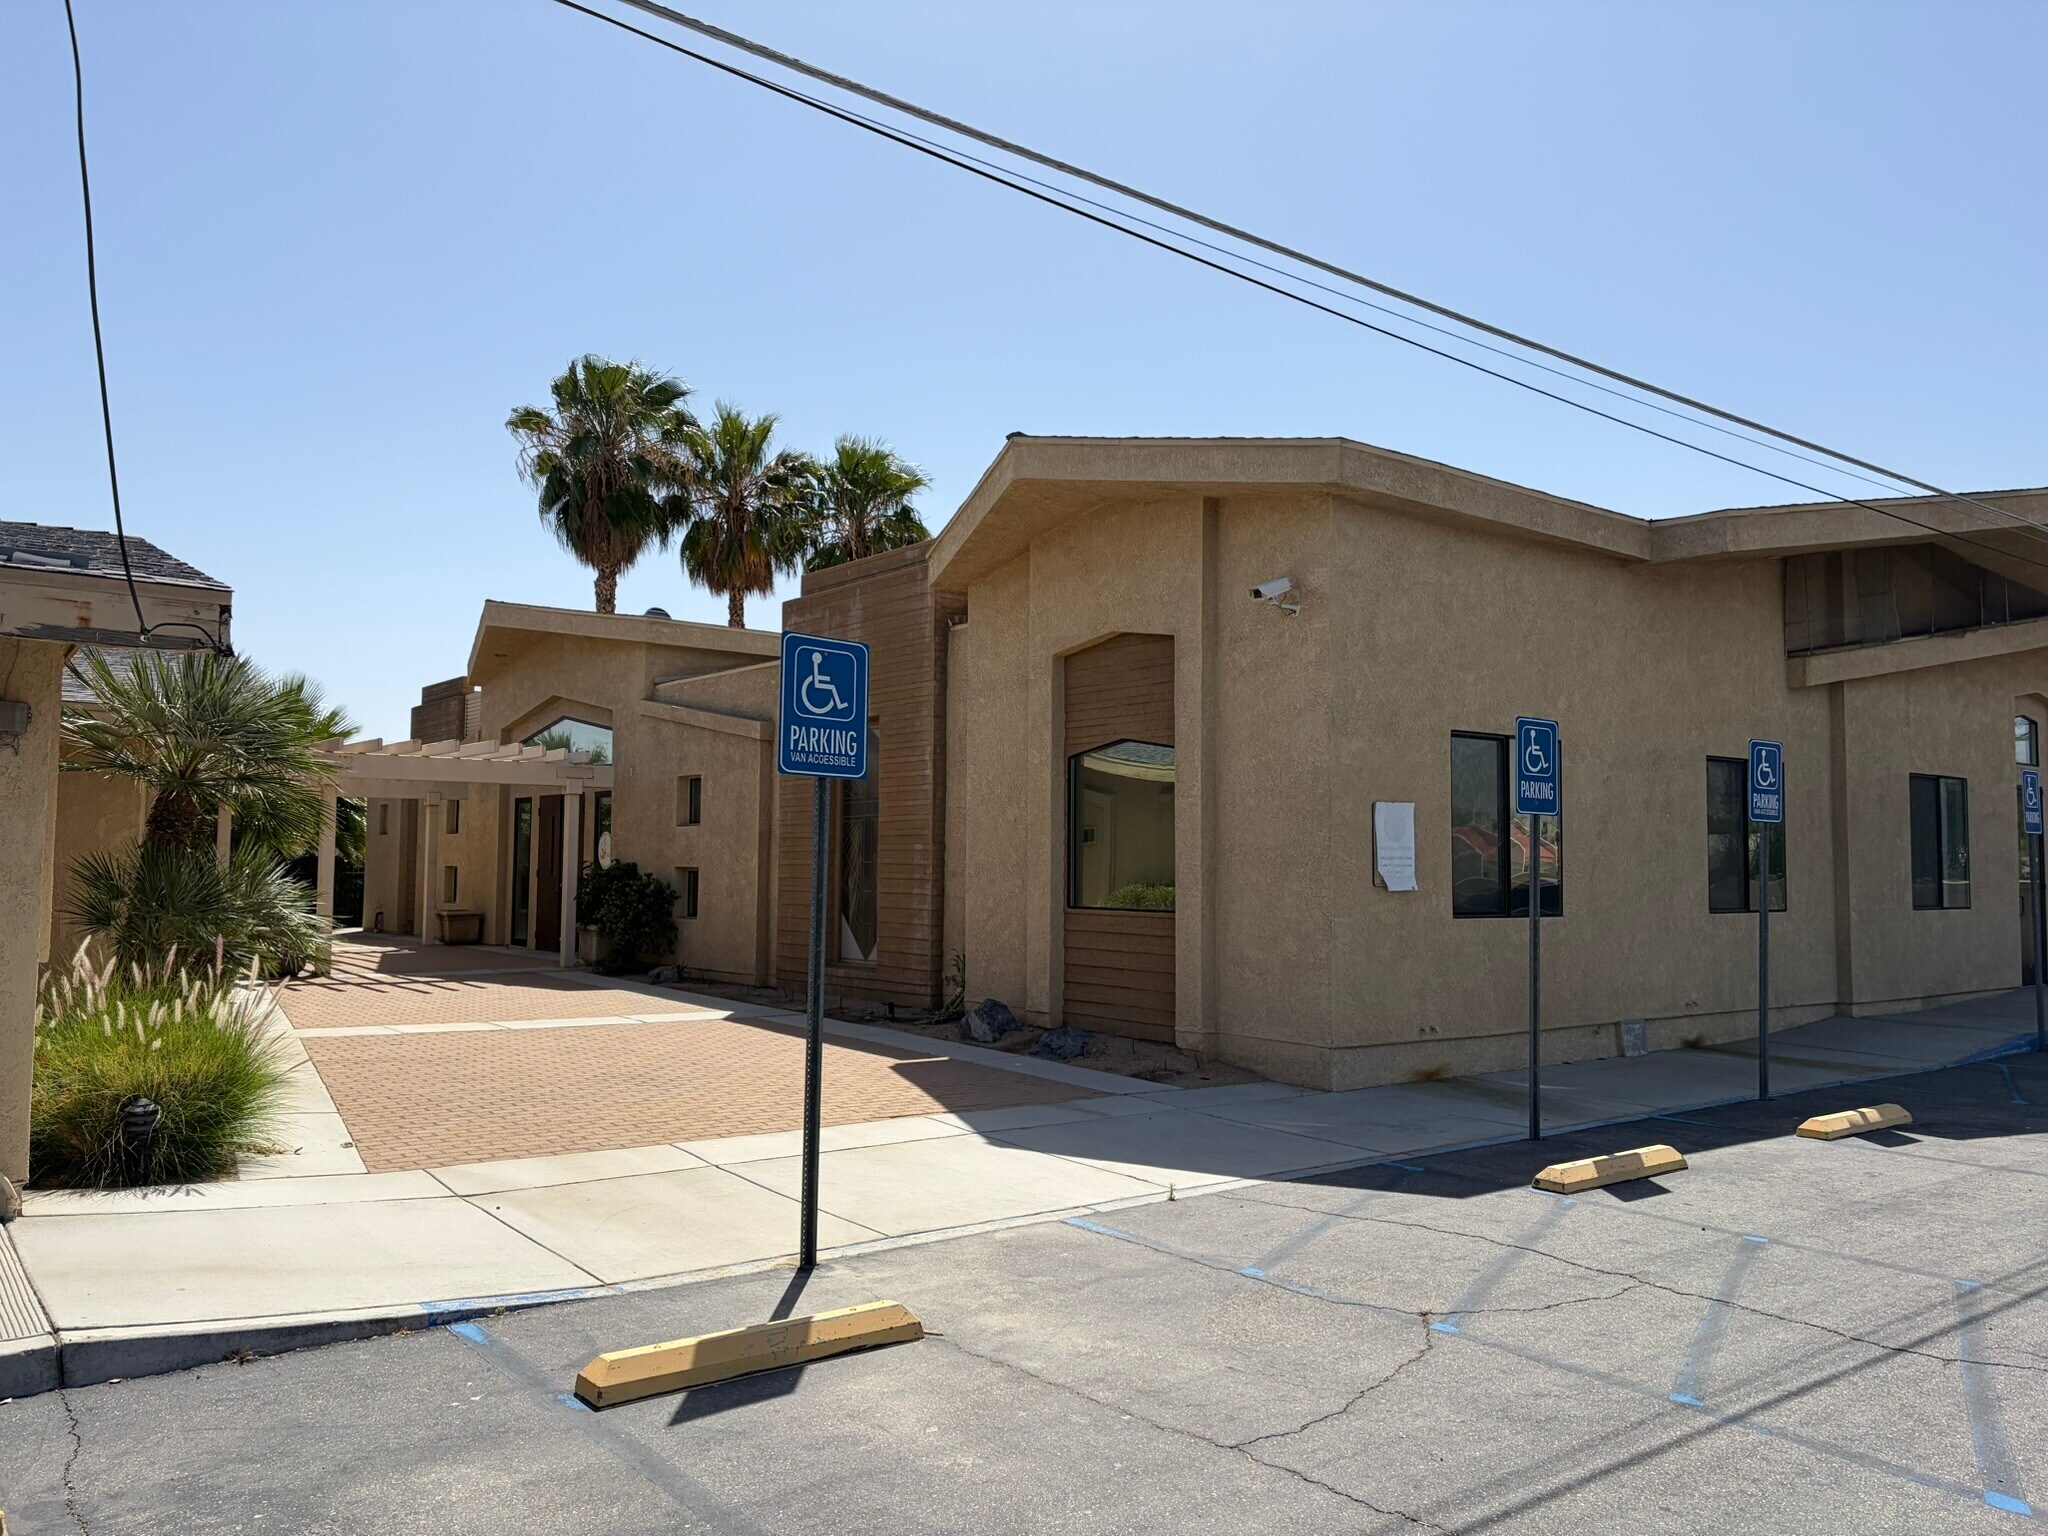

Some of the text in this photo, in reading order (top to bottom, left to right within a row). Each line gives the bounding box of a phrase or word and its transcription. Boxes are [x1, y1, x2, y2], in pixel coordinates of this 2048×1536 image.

[790, 725, 857, 756] PARKING
[790, 752, 856, 767] VAN ACCESSIBLE
[1520, 780, 1554, 800] PARKING
